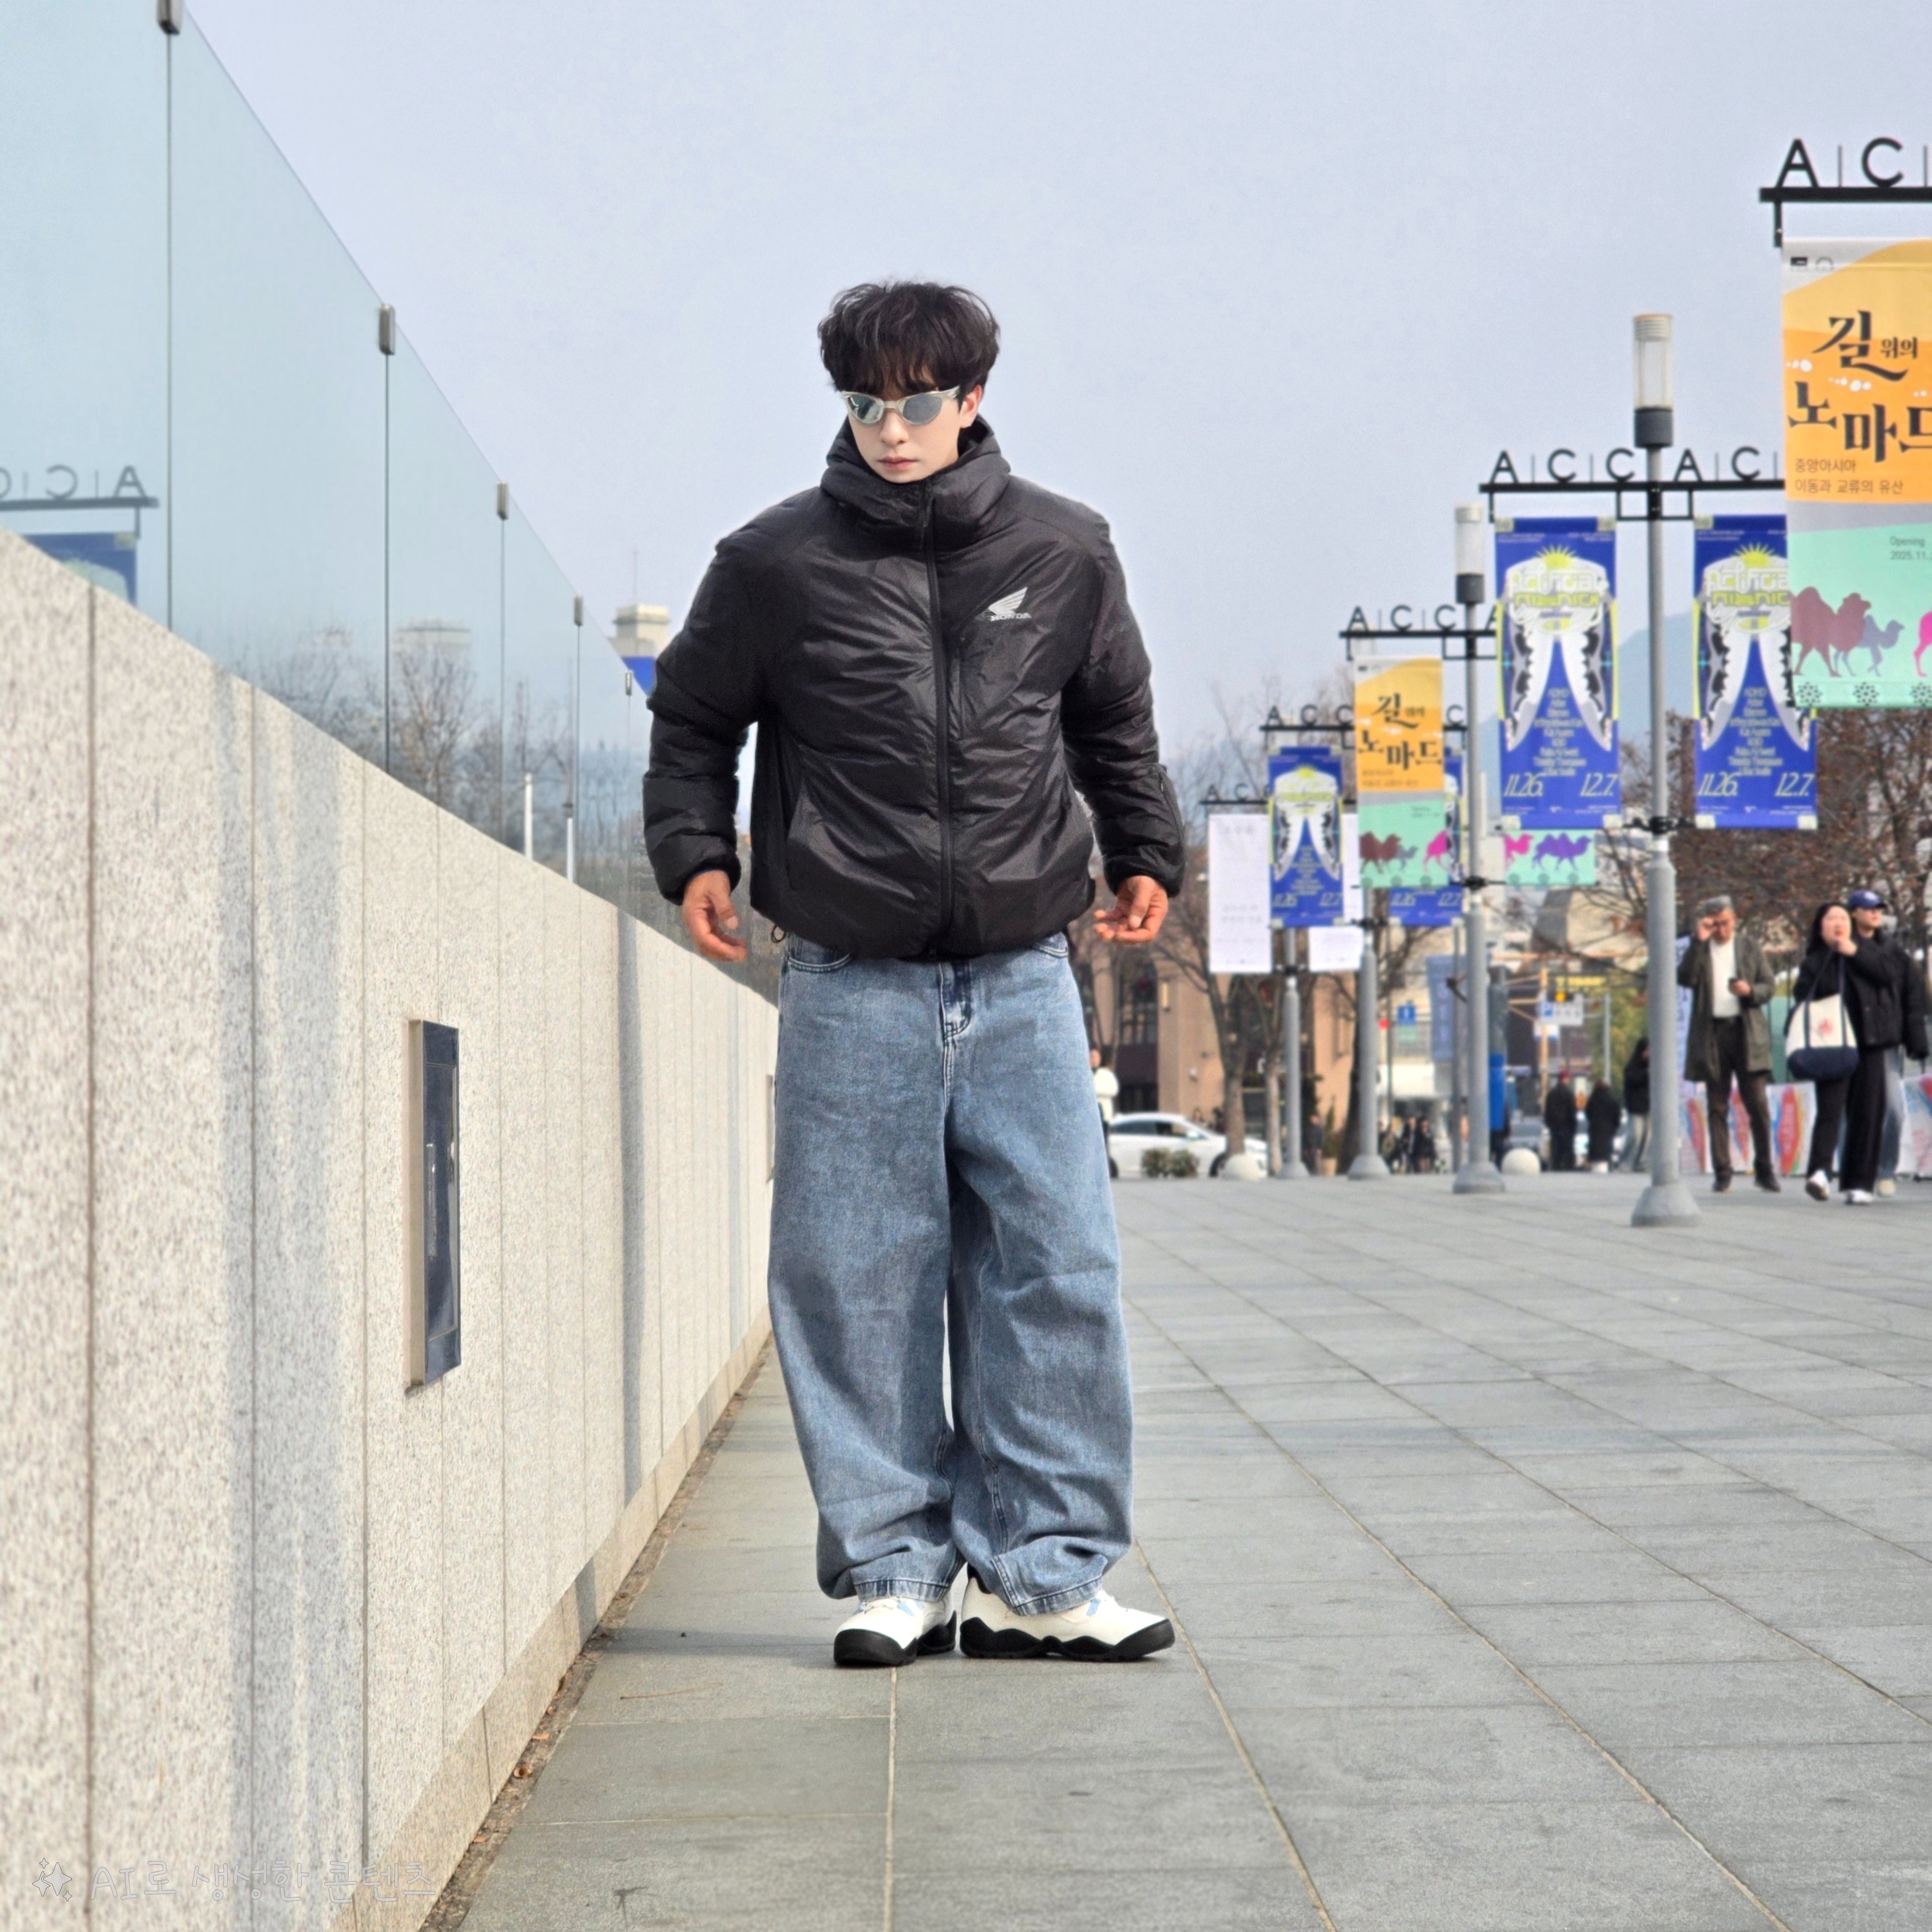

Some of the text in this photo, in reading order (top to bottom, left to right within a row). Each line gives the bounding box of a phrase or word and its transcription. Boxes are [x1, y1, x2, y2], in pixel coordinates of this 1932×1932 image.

[1811, 310, 1918, 382] 길 위의
[1787, 381, 1932, 463] 노마드
[1794, 458, 1856, 473] 중앙아시아
[1794, 479, 1904, 495] 이동과 교류의 유산
[1889, 535, 1926, 548] Opening
[990, 612, 1032, 621] HONDA
[1358, 730, 1442, 770] 노마드
